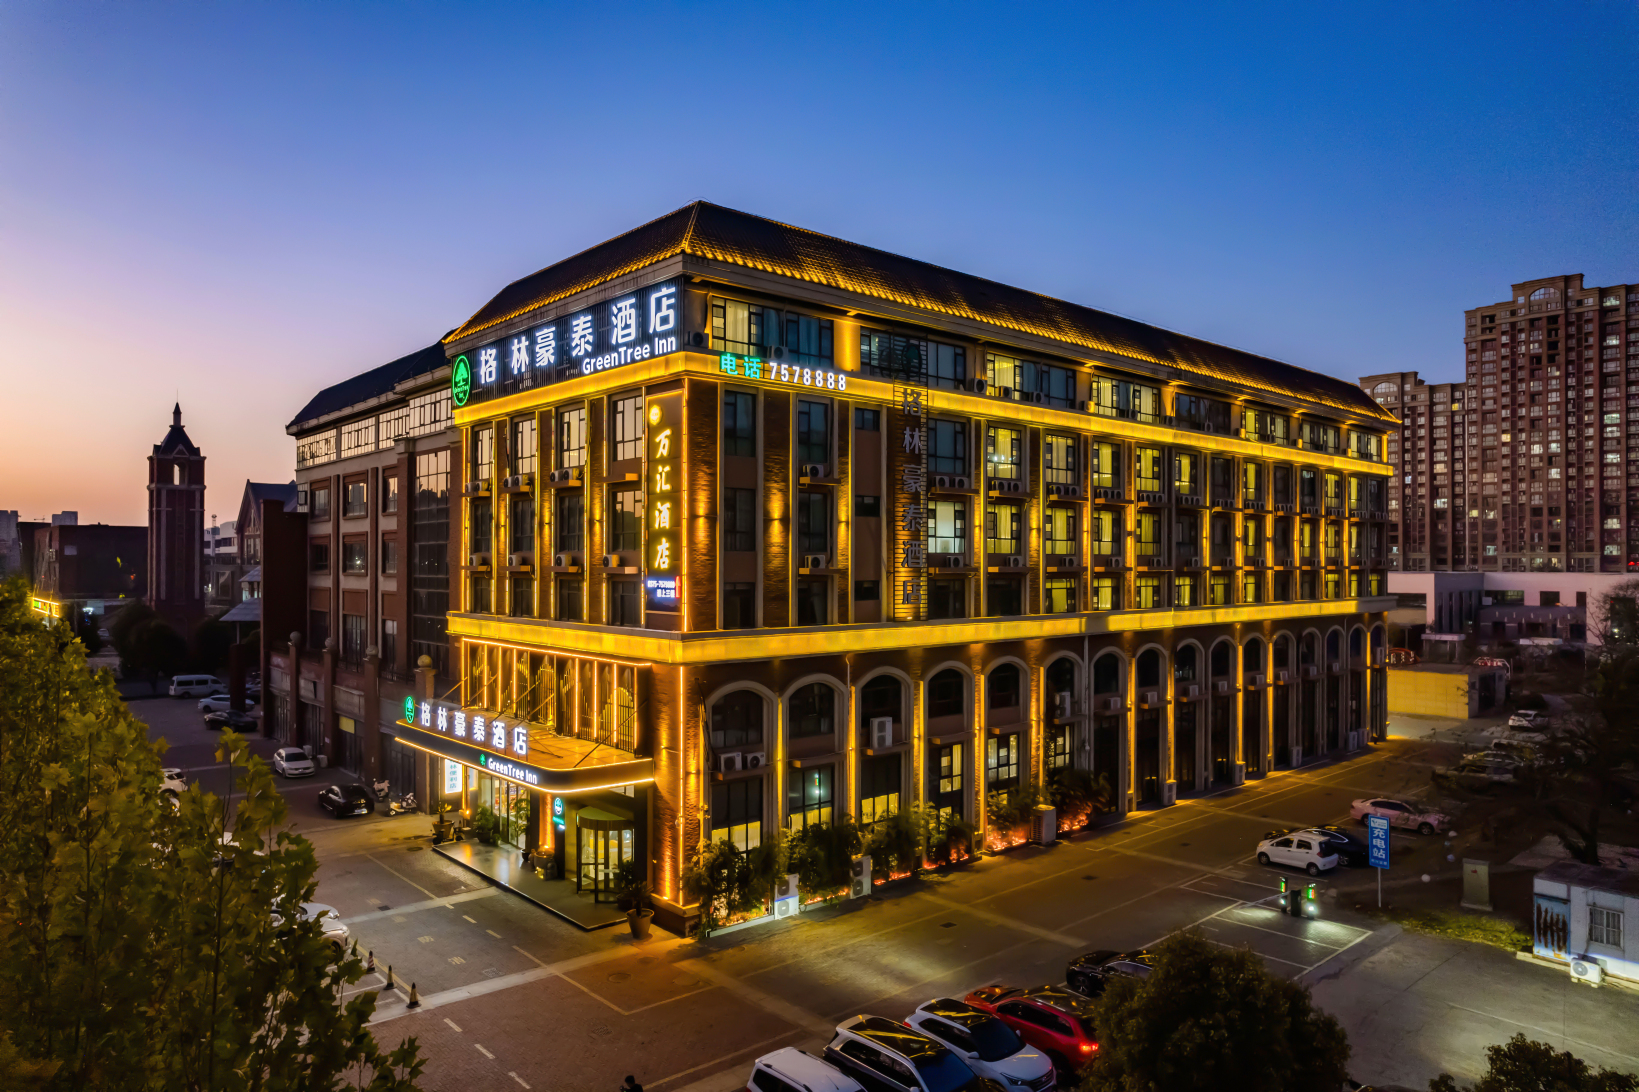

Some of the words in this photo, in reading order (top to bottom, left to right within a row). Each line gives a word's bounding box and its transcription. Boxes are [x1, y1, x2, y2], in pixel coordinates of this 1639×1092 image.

[480, 287, 676, 384] 格林豪泰酒店
[583, 343, 651, 374] GreenTree
[654, 336, 677, 355] Inn
[721, 353, 761, 379] 电话
[770, 362, 846, 390] 7578888
[655, 429, 671, 569] 万汇酒店
[902, 388, 923, 604] 格林豪泰酒店
[421, 702, 527, 755] 格林豪泰酒店
[488, 758, 525, 780] GreenTree
[525, 769, 538, 784] Inn
[1372, 828, 1386, 859] 充电站
